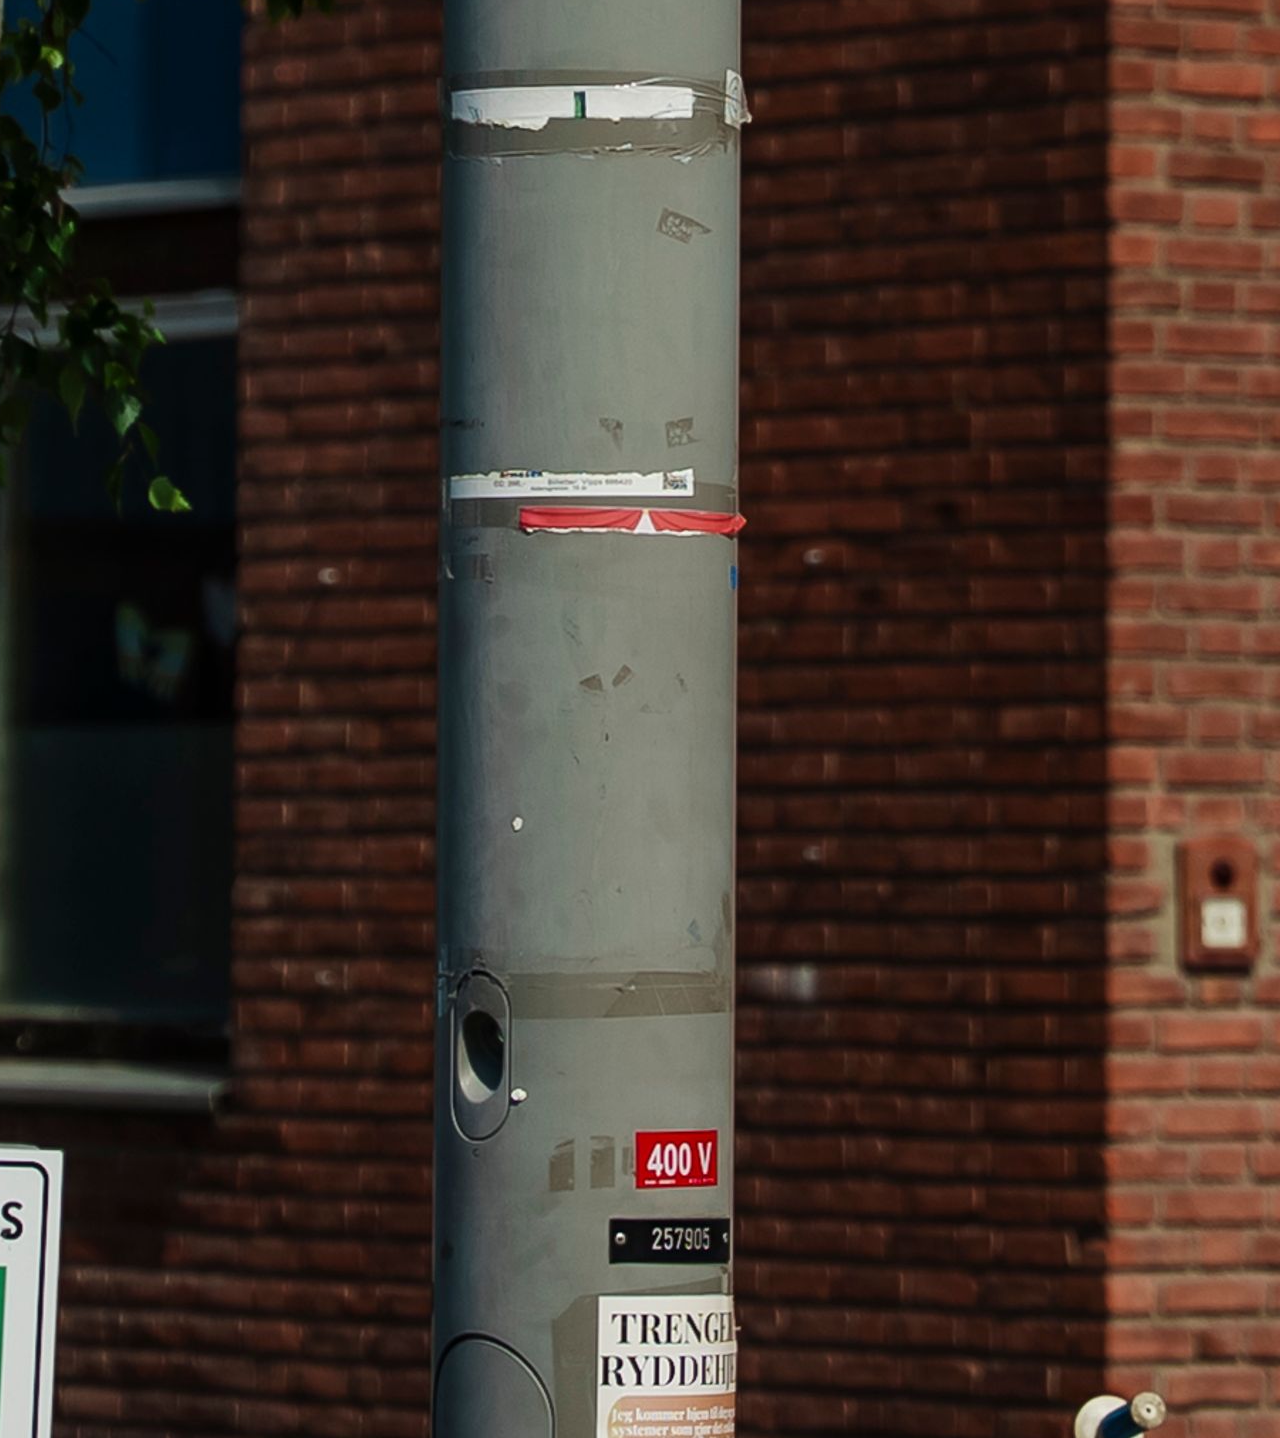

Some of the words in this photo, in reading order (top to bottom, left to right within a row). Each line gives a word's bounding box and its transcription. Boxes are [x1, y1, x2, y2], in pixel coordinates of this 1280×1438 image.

[646, 1142, 692, 1177] 400
[697, 1141, 713, 1176] V
[651, 1227, 711, 1250] 257905
[611, 1425, 669, 1438] systemer
